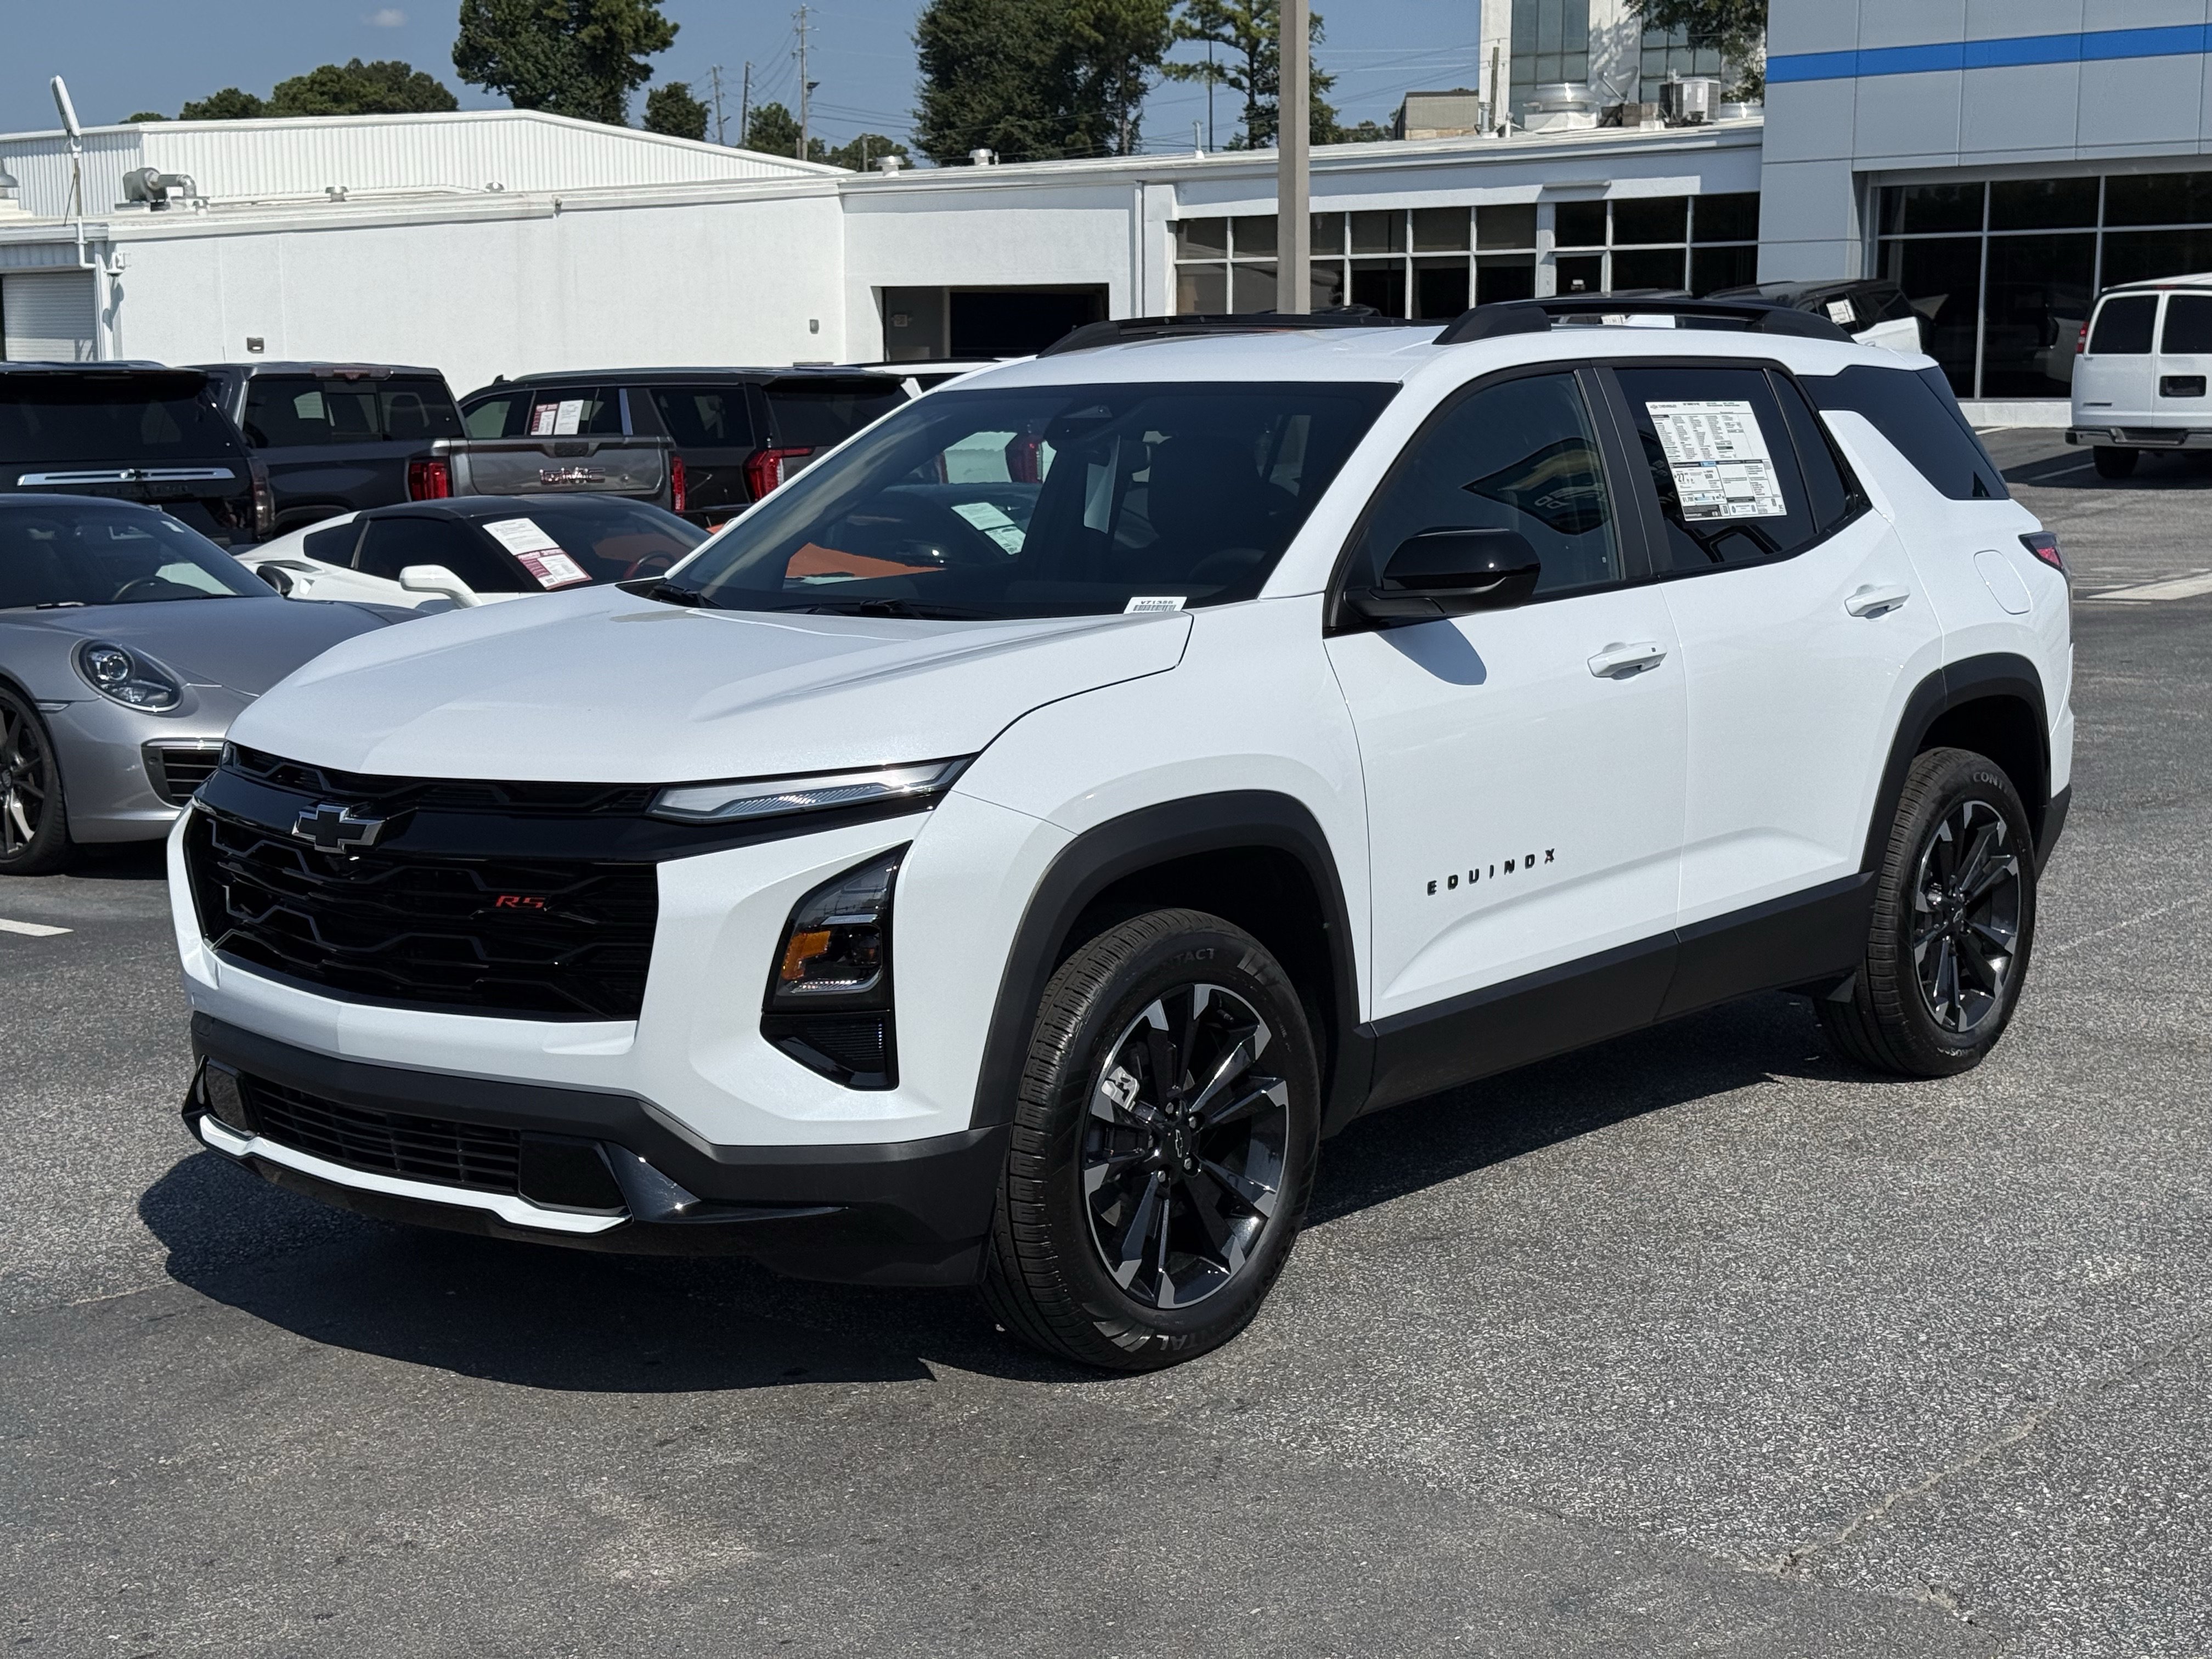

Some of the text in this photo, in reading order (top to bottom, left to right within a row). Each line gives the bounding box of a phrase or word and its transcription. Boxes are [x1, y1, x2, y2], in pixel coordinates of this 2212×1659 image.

[539, 467, 606, 484] GMC
[1427, 848, 1555, 896] EQUINOX
[496, 895, 545, 909] RS
